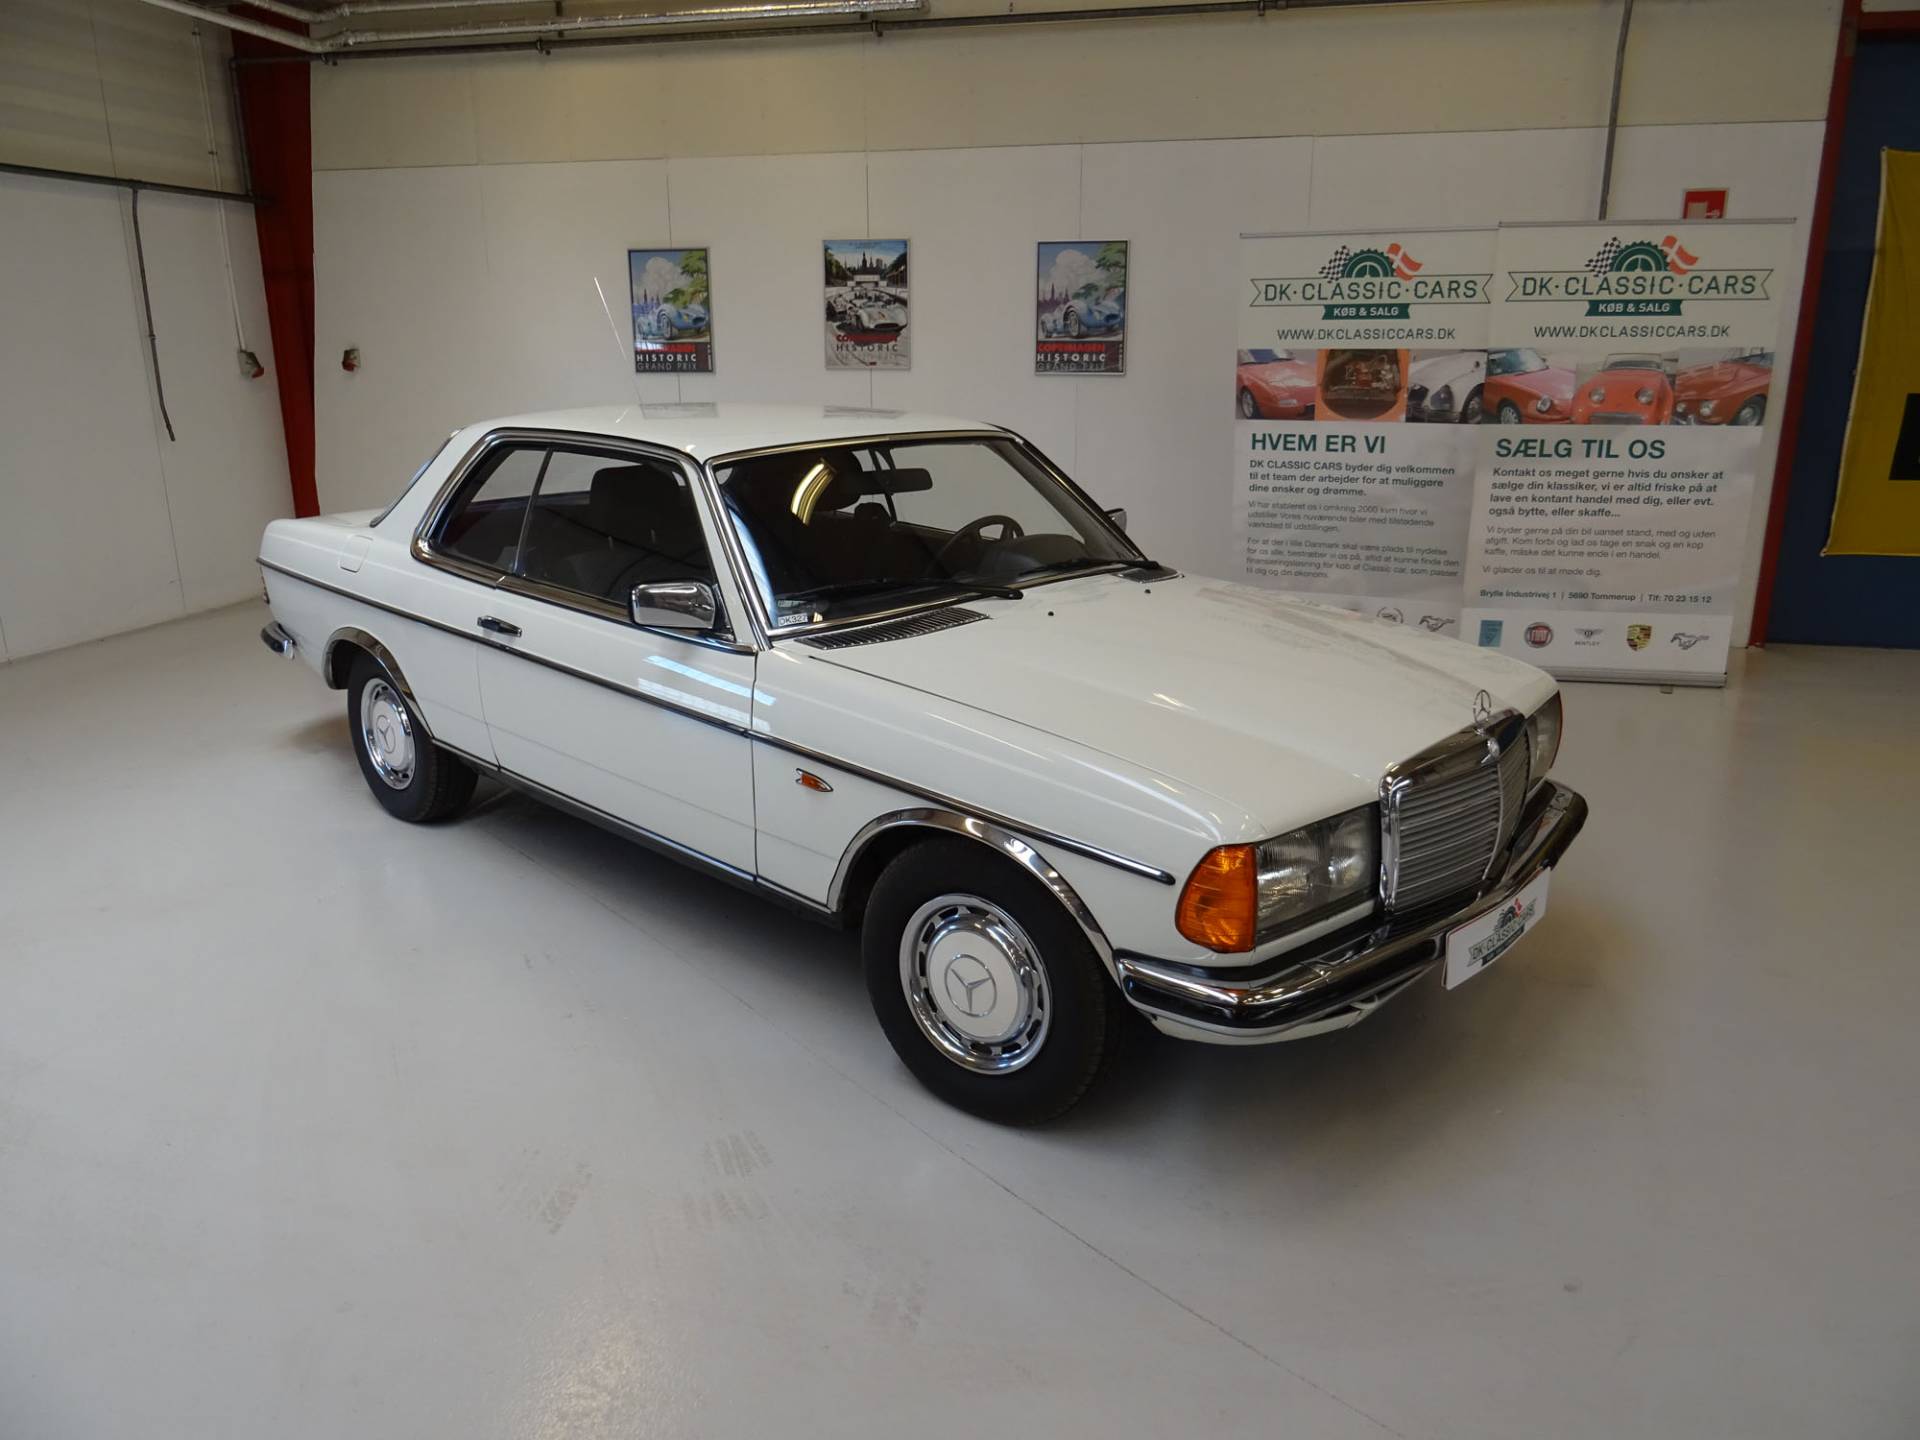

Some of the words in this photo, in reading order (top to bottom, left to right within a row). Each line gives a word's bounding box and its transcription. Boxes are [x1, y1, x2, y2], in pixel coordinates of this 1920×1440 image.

[1333, 307, 1355, 317] KØB
[1359, 307, 1367, 317] &
[1370, 307, 1399, 317] SALG
[1599, 303, 1624, 313] KØB
[1627, 303, 1636, 313] &
[1638, 303, 1670, 312] SALG
[1277, 328, 1456, 340] WWW.DKCLASSICCARS.DK
[1533, 325, 1730, 338] WWW.DKCLASSICCARS.DK
[836, 344, 898, 352] HISTORIC
[636, 354, 697, 362] HISTORIC
[1037, 353, 1106, 362] HISTORIC
[1251, 433, 1317, 451] HVEM
[1325, 434, 1356, 453] ER
[1364, 435, 1386, 454] VI
[1496, 439, 1573, 458] SÆLG
[1582, 440, 1619, 459] TIL
[1628, 440, 1666, 459] OS
[1249, 460, 1264, 469] DK
[1267, 460, 1311, 470] CLASSIC
[1313, 462, 1343, 471] CARS
[1345, 463, 1374, 473] byder
[1376, 464, 1392, 474] dig
[1394, 465, 1455, 475] velkommen
[1492, 467, 1536, 477] Kontakt
[1538, 469, 1552, 477] os
[1555, 468, 1589, 480] meget
[1592, 470, 1625, 480] gerne
[1628, 469, 1650, 479] hvis
[1653, 469, 1668, 479] du
[1670, 470, 1709, 480] ønsker
[1712, 471, 1724, 480] at
[1249, 472, 1259, 480] til
[1260, 473, 1270, 481] et
[1272, 473, 1297, 481] team
[1299, 474, 1316, 482] der
[1318, 475, 1360, 485] arbejder
[1362, 476, 1376, 484] for
[1379, 477, 1389, 485] at
[1392, 478, 1444, 488] muliggøre
[1249, 484, 1269, 492] dine
[1272, 485, 1305, 494] ønsker
[1307, 487, 1320, 496] og
[1322, 486, 1367, 496] drømme.
[1491, 481, 1525, 492] sælge
[1527, 481, 1544, 490] din
[1547, 482, 1598, 492] klassiker,
[1601, 482, 1610, 491] vi
[1627, 482, 1652, 492] altid
[1654, 483, 1686, 493] friske
[1689, 483, 1703, 494] på
[1706, 484, 1717, 493] at
[1490, 493, 1512, 503] lave
[1514, 495, 1528, 503] en
[1531, 494, 1573, 503] kontant
[1575, 495, 1613, 504] handel
[1616, 496, 1640, 505] med
[1643, 496, 1663, 507] dig,
[1667, 497, 1691, 506] eller
[1693, 498, 1714, 506] evt.
[1489, 506, 1515, 517] også
[1518, 507, 1548, 517] bytte,
[1551, 507, 1575, 516] eller
[1578, 508, 1621, 517] skaffe...
[1524, 528, 1549, 536] gerne
[1551, 527, 1563, 536] på
[1565, 527, 1579, 535] din
[1656, 529, 1677, 537] med
[1678, 531, 1691, 539] og
[1693, 530, 1716, 538] uden
[1512, 537, 1533, 545] Kom
[1557, 539, 1569, 548] og
[1658, 542, 1671, 550] og
[1687, 542, 1704, 551] kop
[1591, 592, 1636, 602] Tommerup
[1664, 594, 1674, 602] 70
[1675, 594, 1686, 603] 23
[1689, 595, 1699, 603] 15
[1702, 595, 1712, 603] 12
